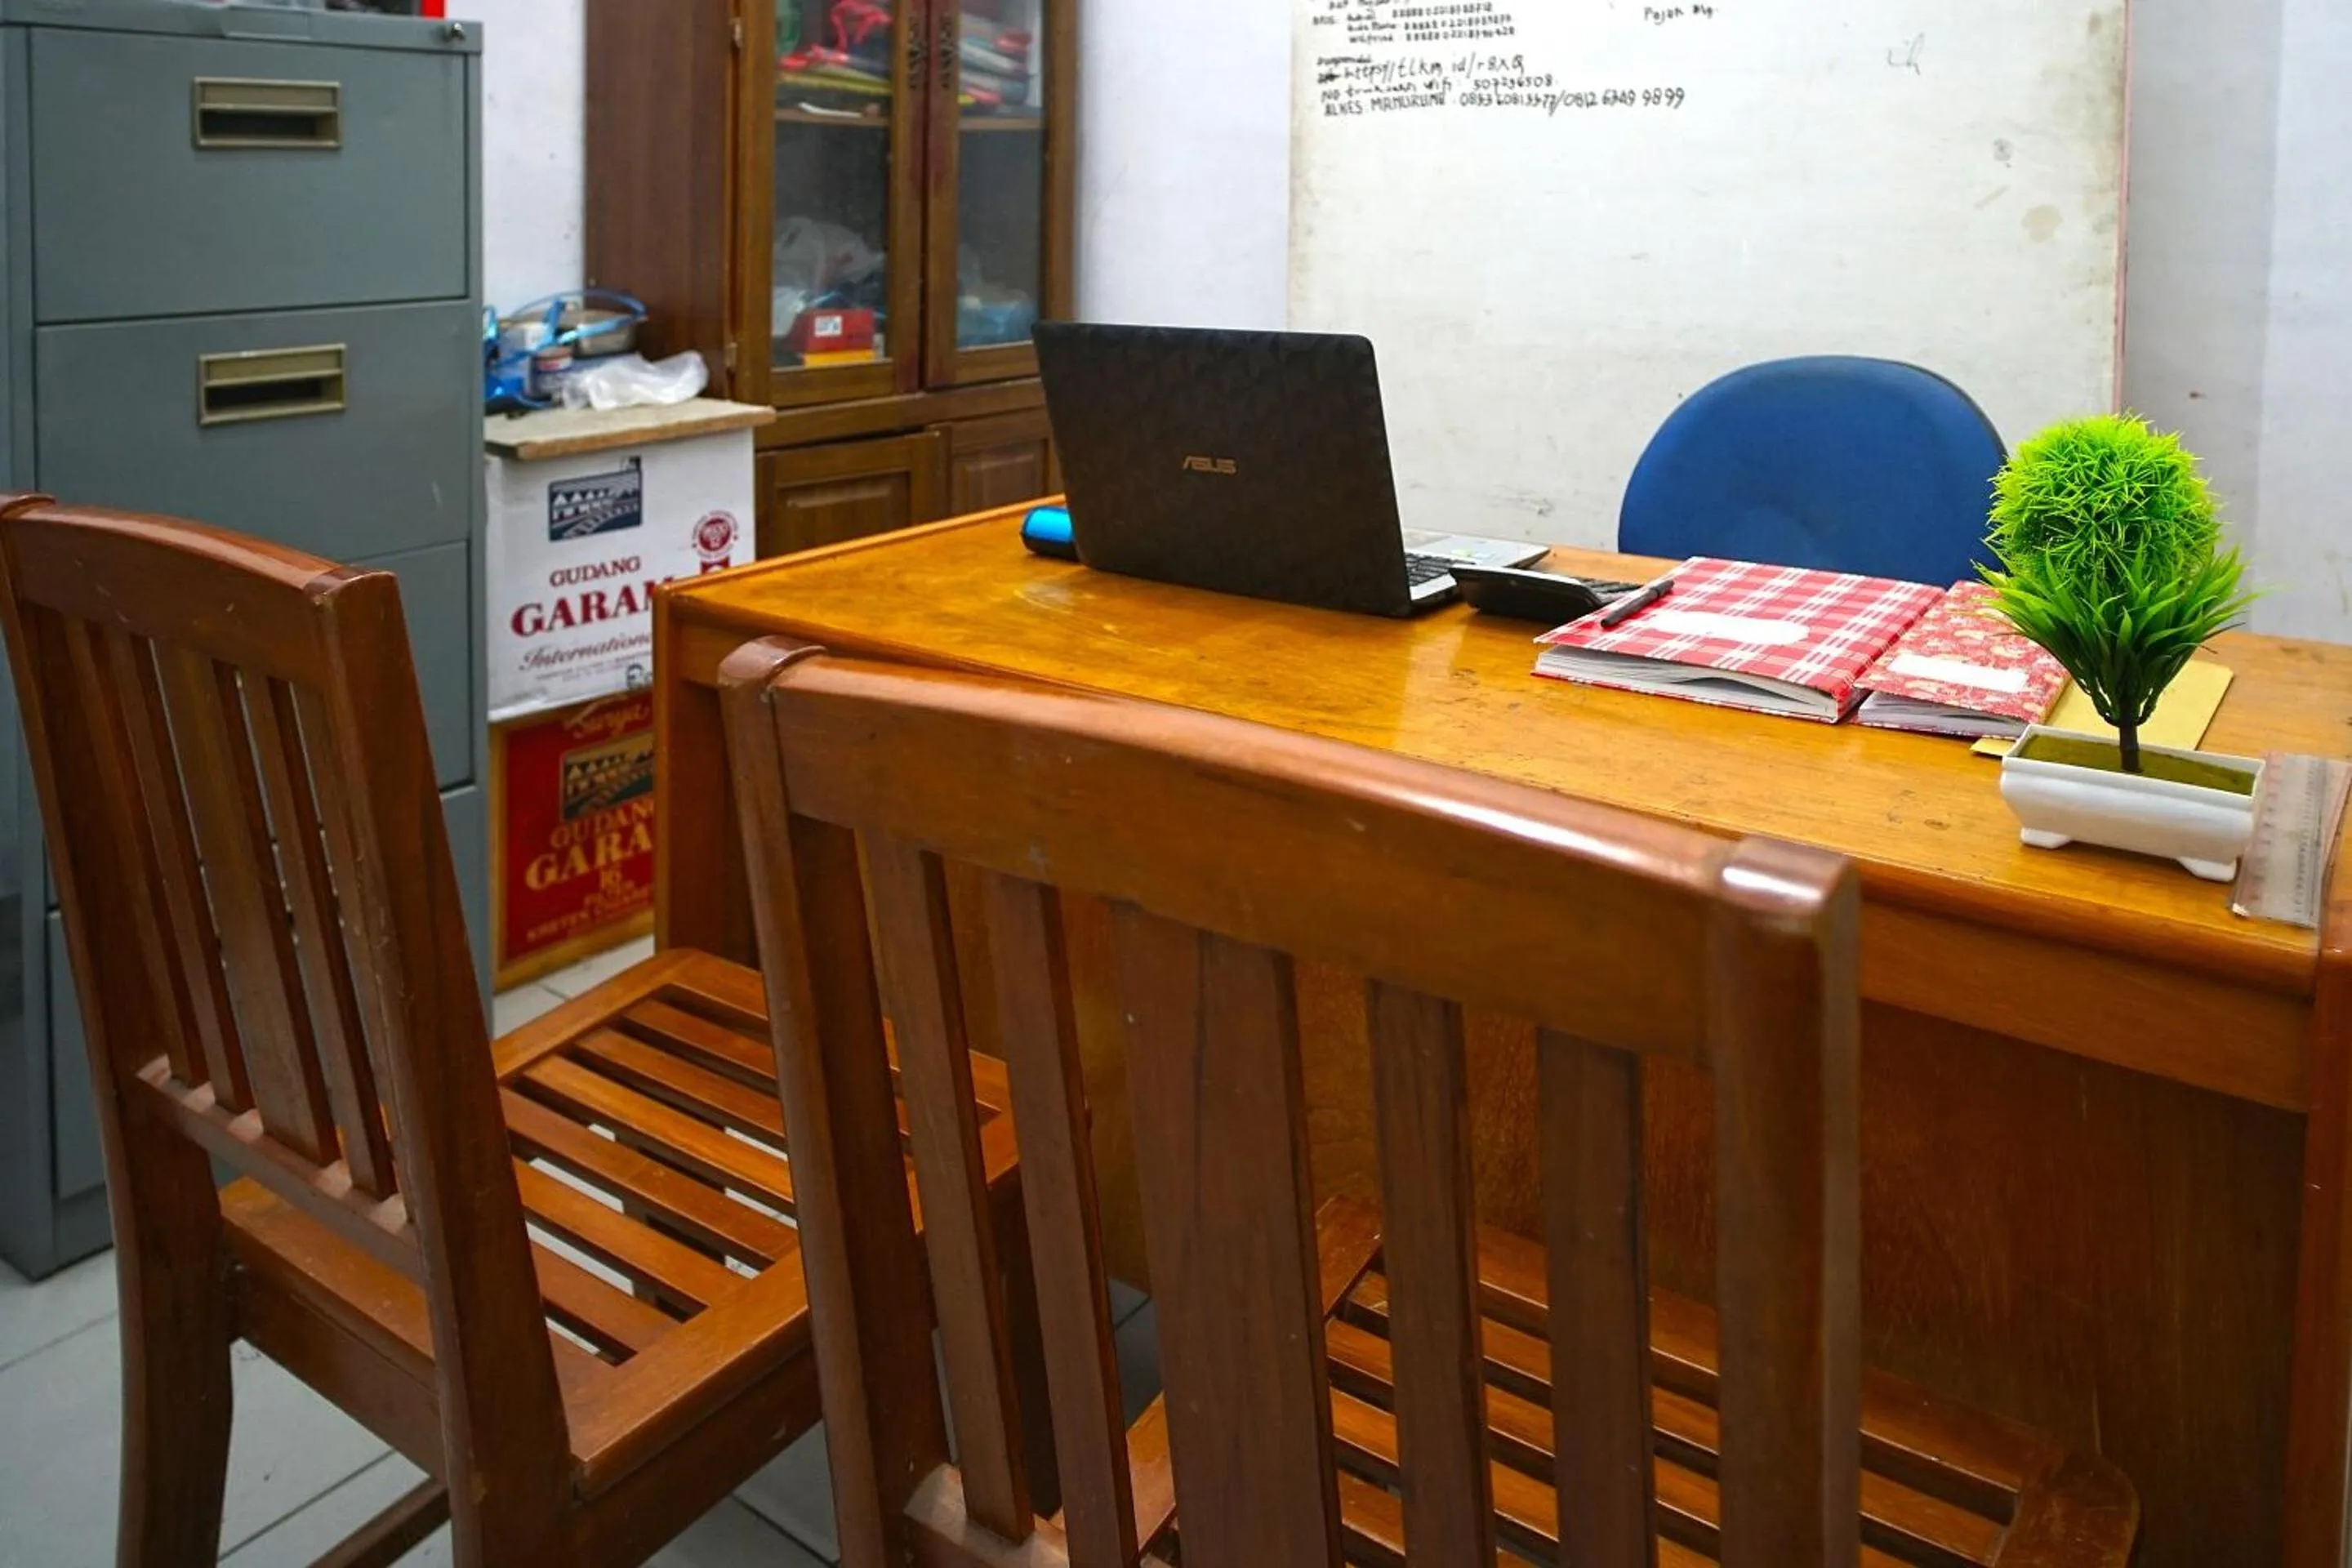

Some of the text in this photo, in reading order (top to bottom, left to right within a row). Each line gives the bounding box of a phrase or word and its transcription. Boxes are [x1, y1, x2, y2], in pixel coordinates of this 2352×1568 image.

[1642, 87, 1686, 109] 9899
[1183, 455, 1237, 474] ASUS
[549, 556, 642, 588] GUDANG
[549, 800, 654, 849] GUDAN
[525, 822, 653, 891] GARA
